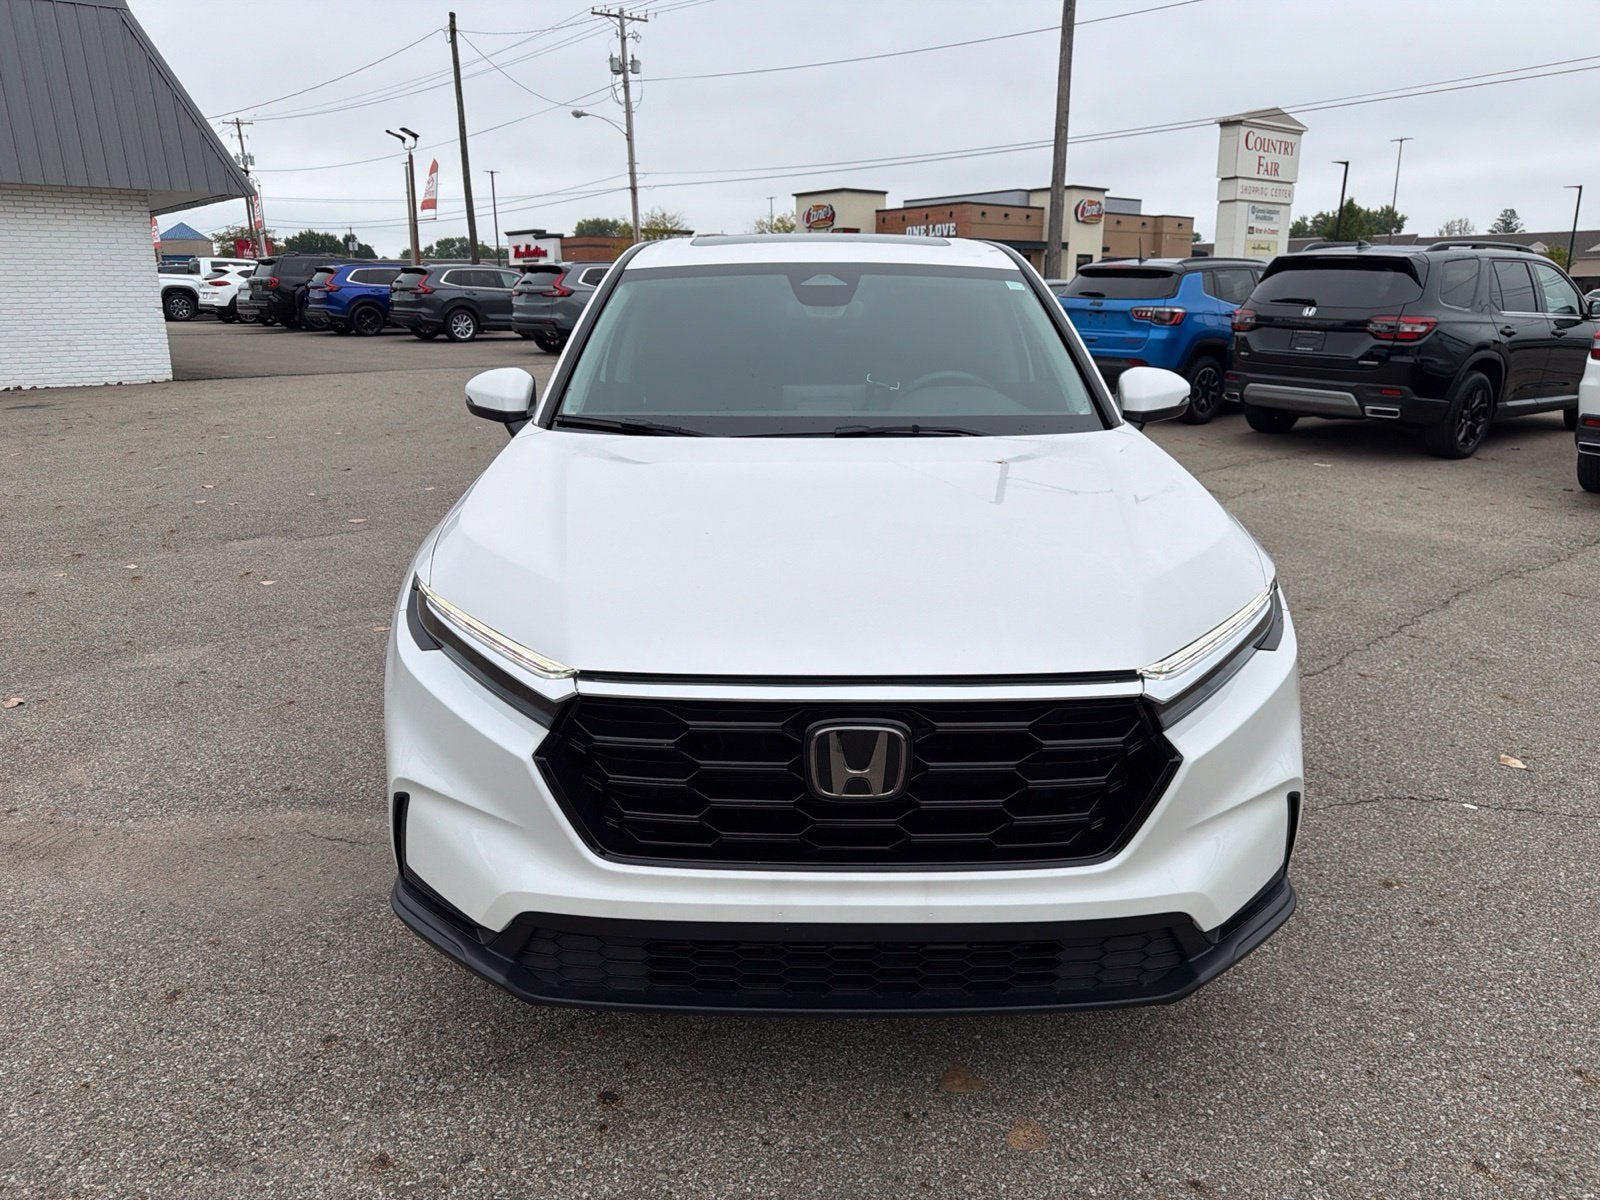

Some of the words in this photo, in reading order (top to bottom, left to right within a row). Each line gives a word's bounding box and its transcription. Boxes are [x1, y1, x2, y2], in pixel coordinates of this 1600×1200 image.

[1244, 130, 1296, 157] COUNTRY
[1256, 155, 1280, 177] FAIR
[1240, 185, 1268, 197] SHOPPING
[1270, 187, 1292, 198] CENTER
[906, 225, 927, 237] ONE
[928, 222, 957, 236] LOVE
